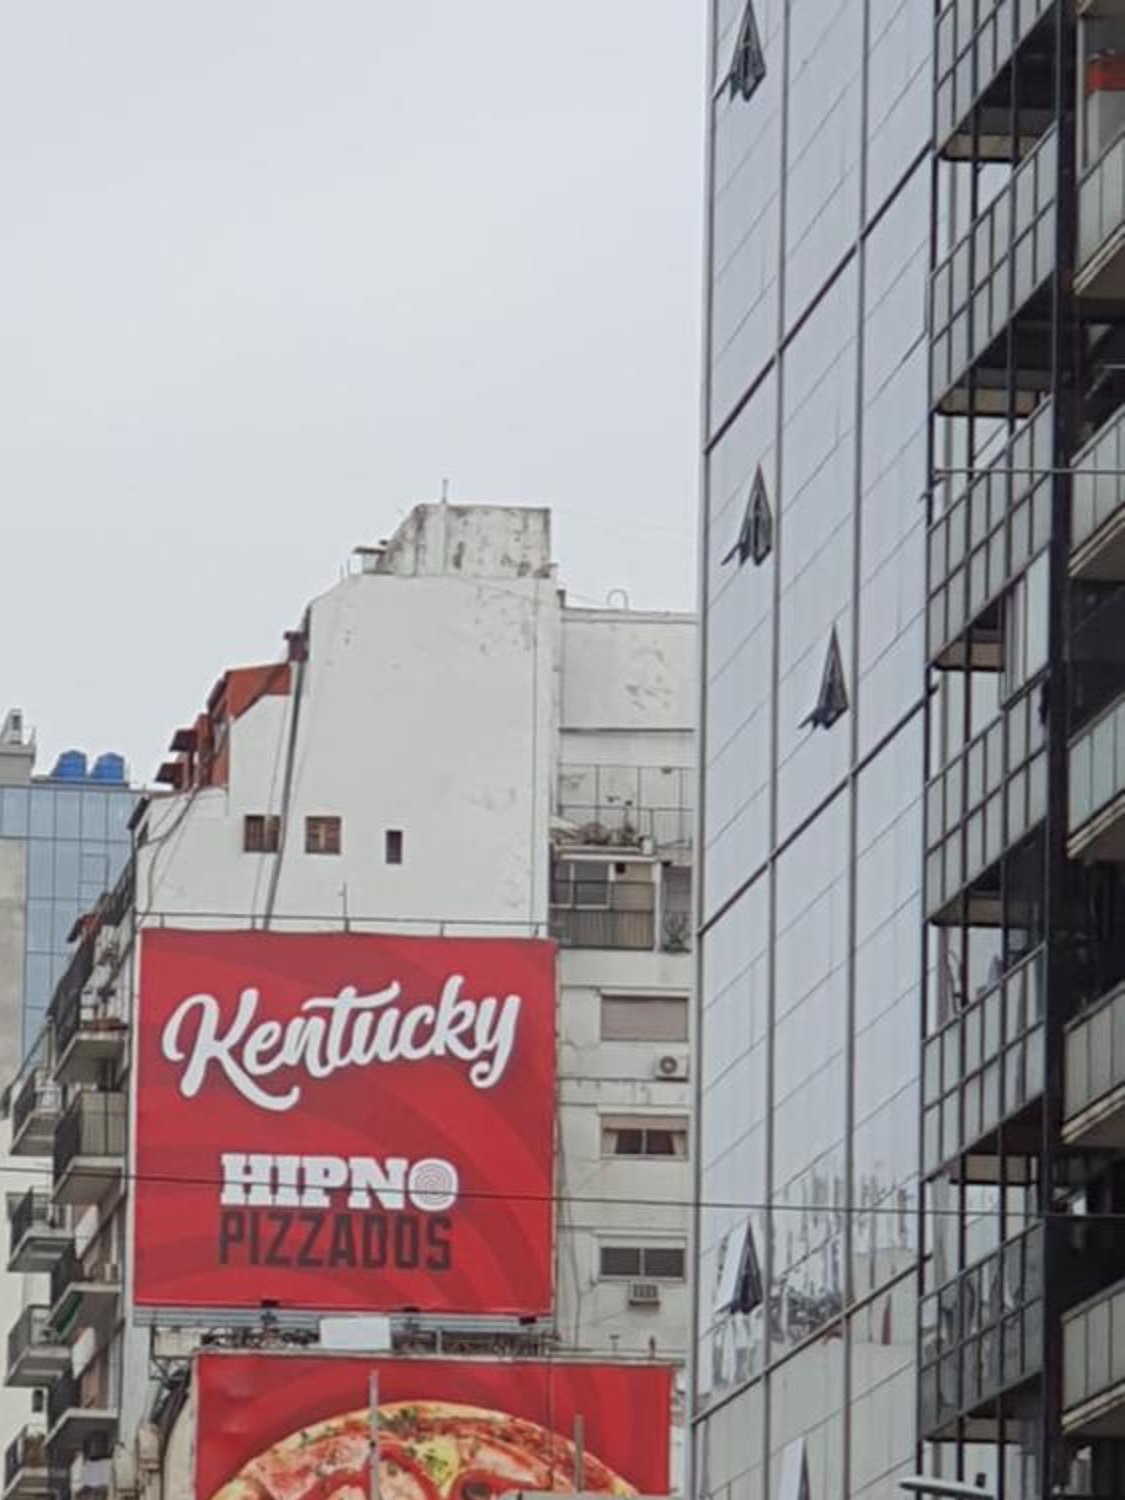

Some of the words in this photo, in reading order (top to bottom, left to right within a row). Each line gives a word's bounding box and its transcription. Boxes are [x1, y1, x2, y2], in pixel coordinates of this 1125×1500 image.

[162, 974, 521, 1113] Kentucky
[219, 1152, 460, 1213] HIPNO
[218, 1207, 454, 1271] PIZZADOS
